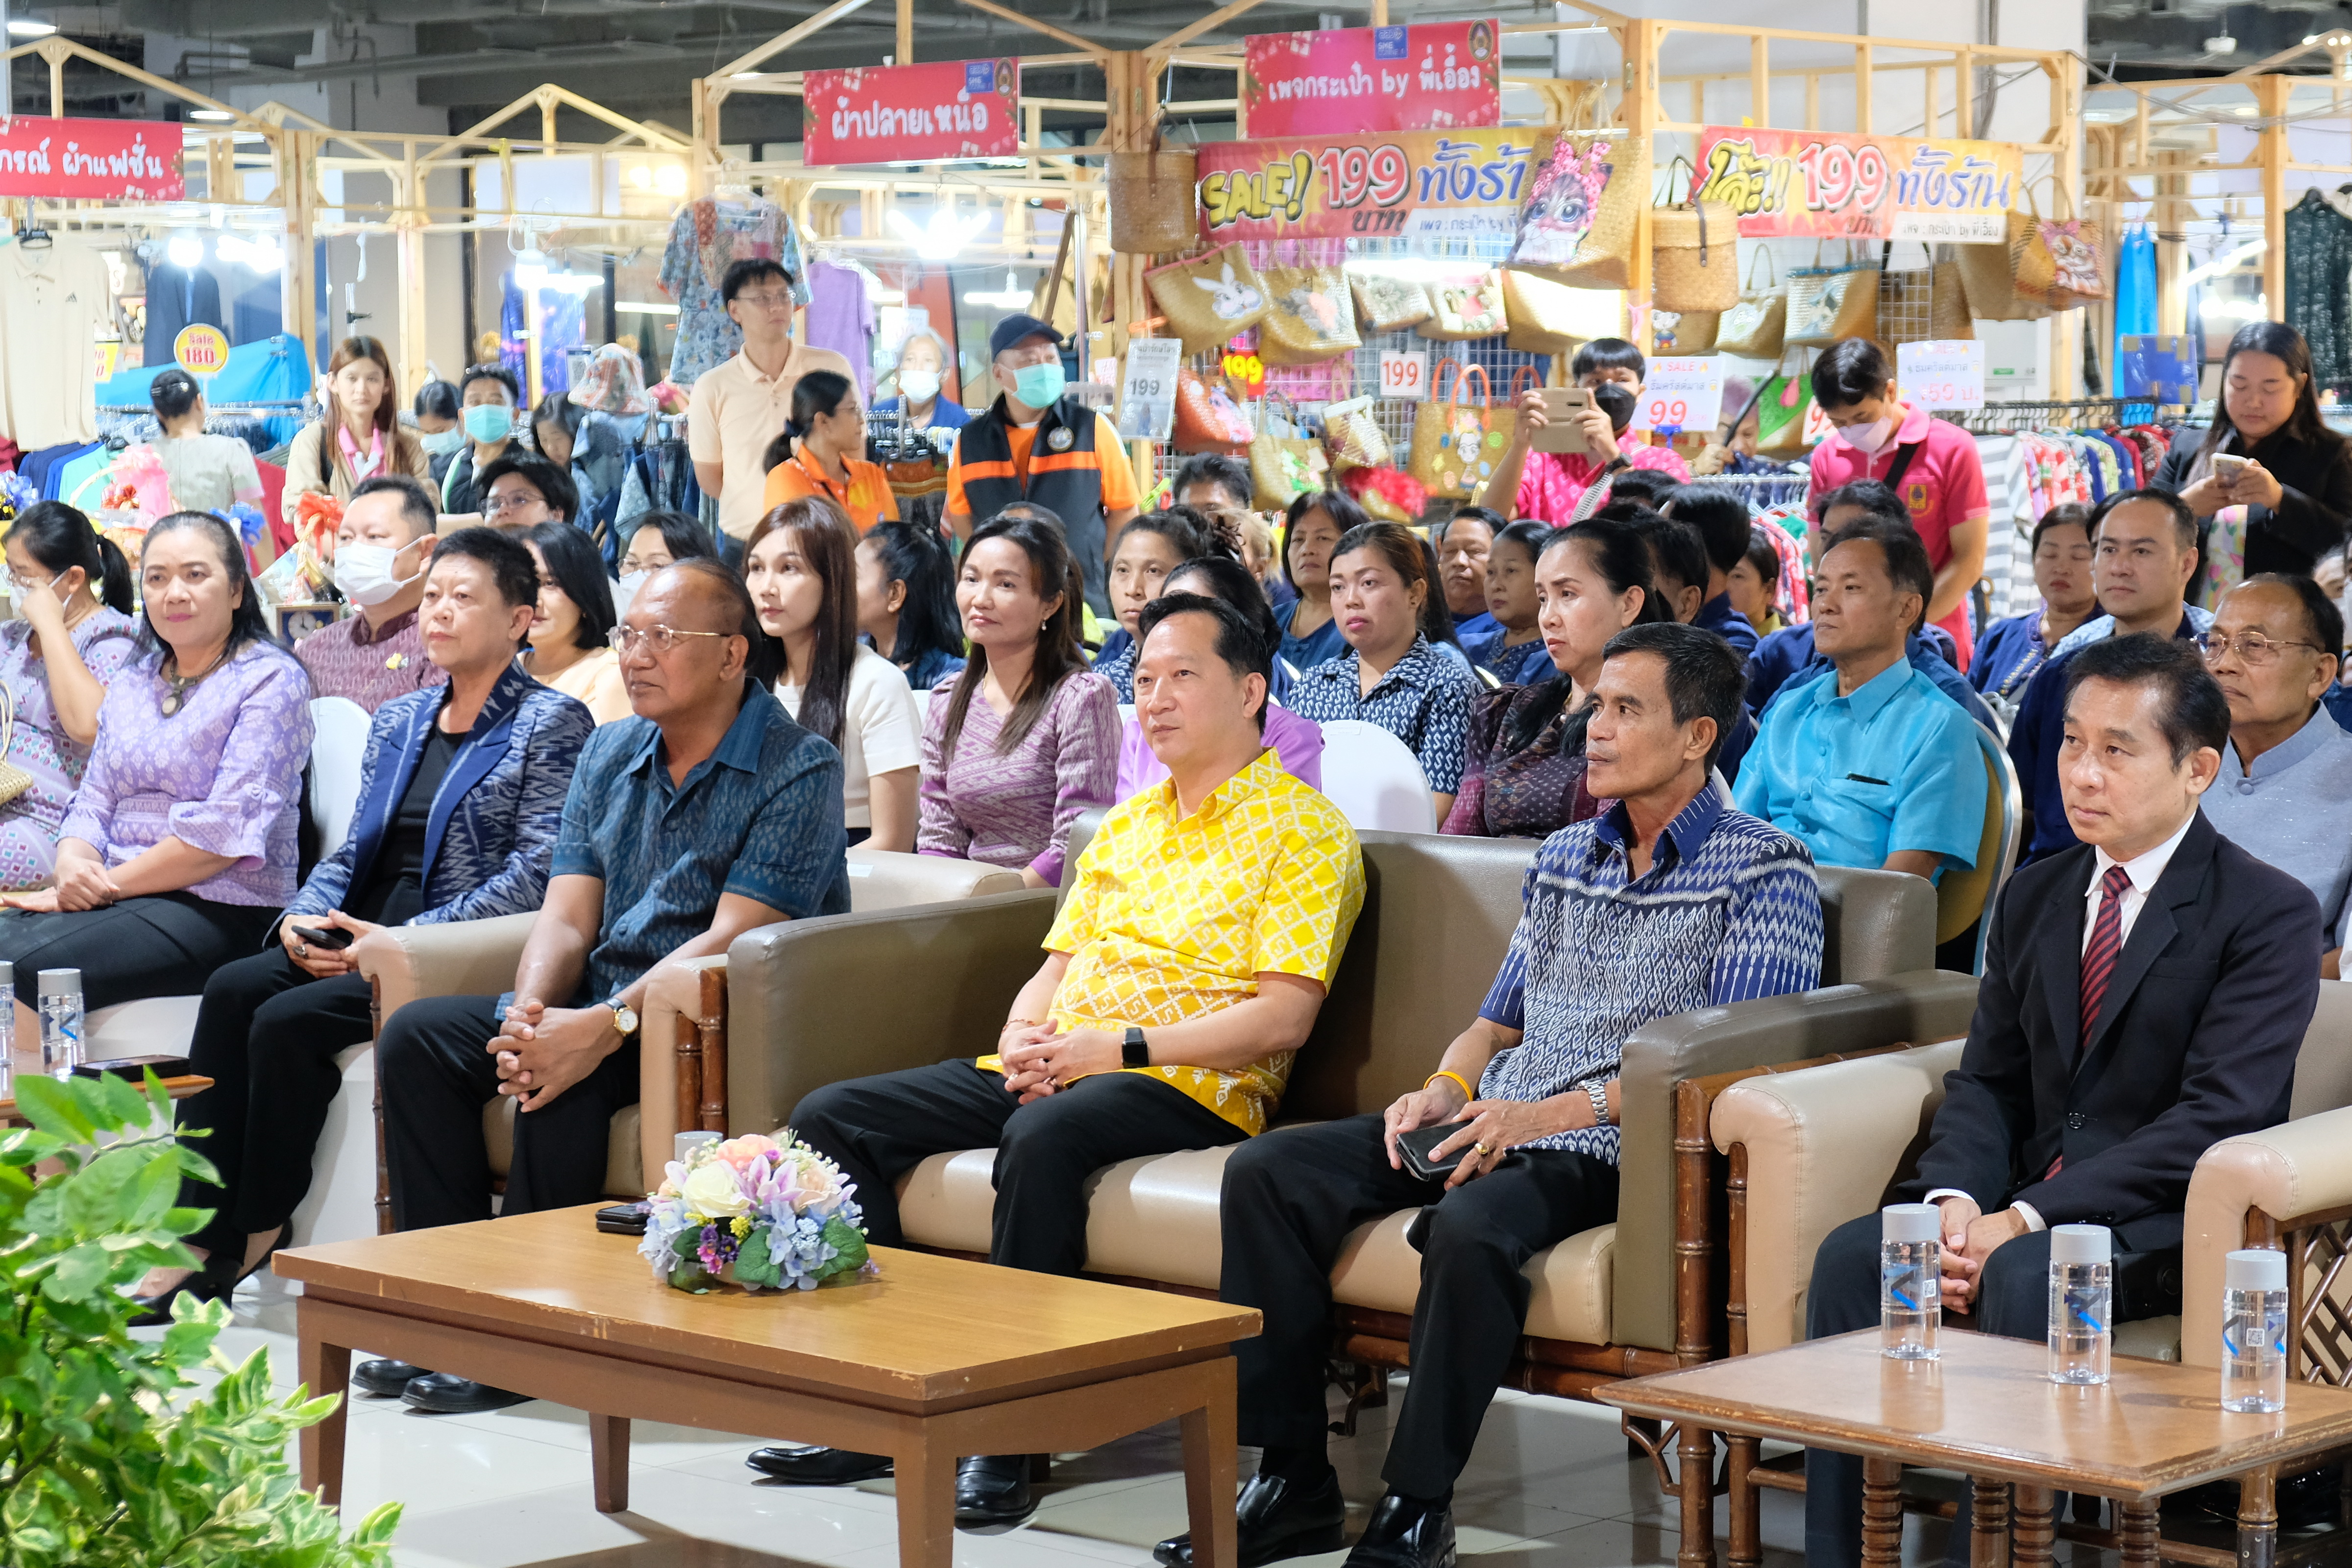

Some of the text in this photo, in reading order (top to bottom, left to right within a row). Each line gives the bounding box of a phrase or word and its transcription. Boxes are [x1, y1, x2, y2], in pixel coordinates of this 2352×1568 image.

[1382, 68, 1409, 98] by
[62, 132, 164, 179] ผ้าแฟชั่น
[1200, 139, 1533, 231] SALE! 199 ทั้งร้า
[1796, 142, 1891, 214] 199
[1895, 145, 2012, 209] ทั้งร้าน
[1352, 209, 1407, 232] บาท
[189, 332, 215, 344] Sale
[182, 346, 216, 366] 180
[1667, 361, 1695, 372] SALE
[1221, 355, 1264, 386] 199
[1129, 378, 1160, 396] 199
[1649, 399, 1688, 425] 99
